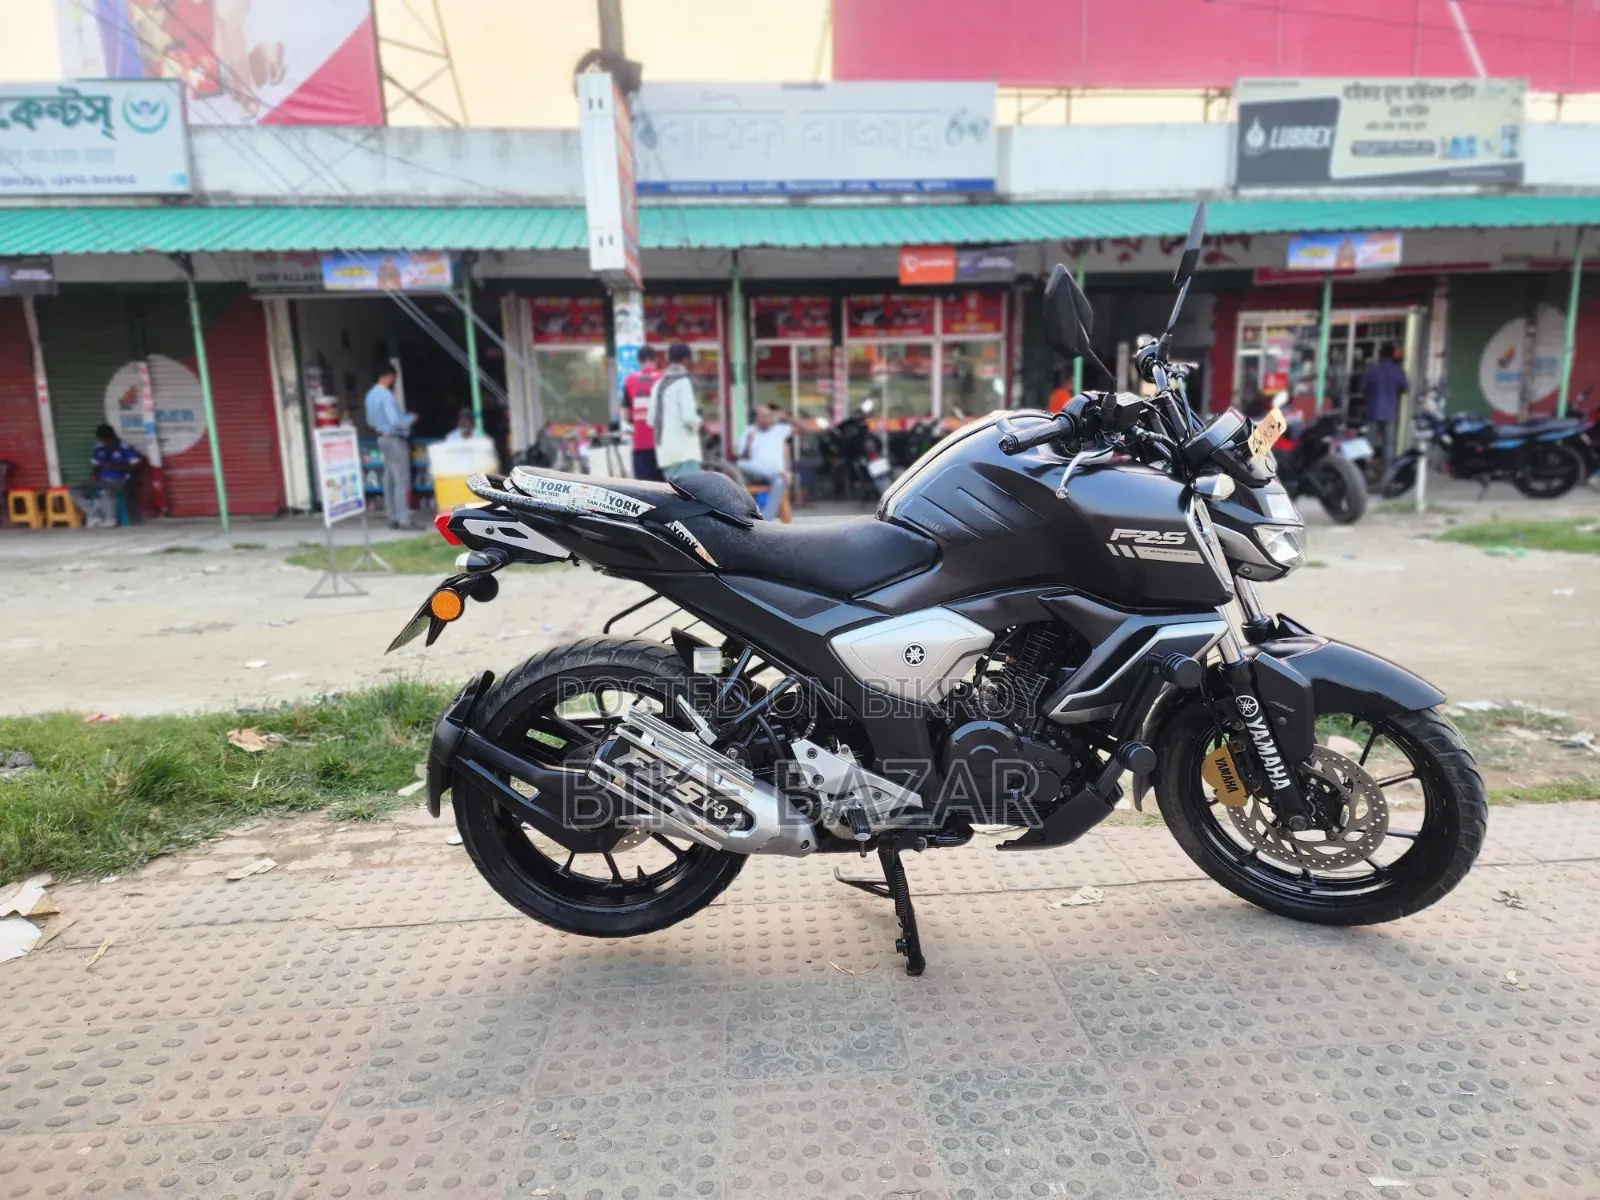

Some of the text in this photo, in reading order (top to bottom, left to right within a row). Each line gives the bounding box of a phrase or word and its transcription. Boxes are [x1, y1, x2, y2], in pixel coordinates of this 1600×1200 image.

[532, 488, 560, 498] FRANCISCO
[540, 482, 571, 494] YORK
[599, 502, 629, 516] FRANCISCO
[609, 495, 641, 515] YORK
[673, 526, 699, 550] YORK
[1246, 716, 1292, 790] YAMAHA
[1215, 757, 1239, 794] YAMAHA
